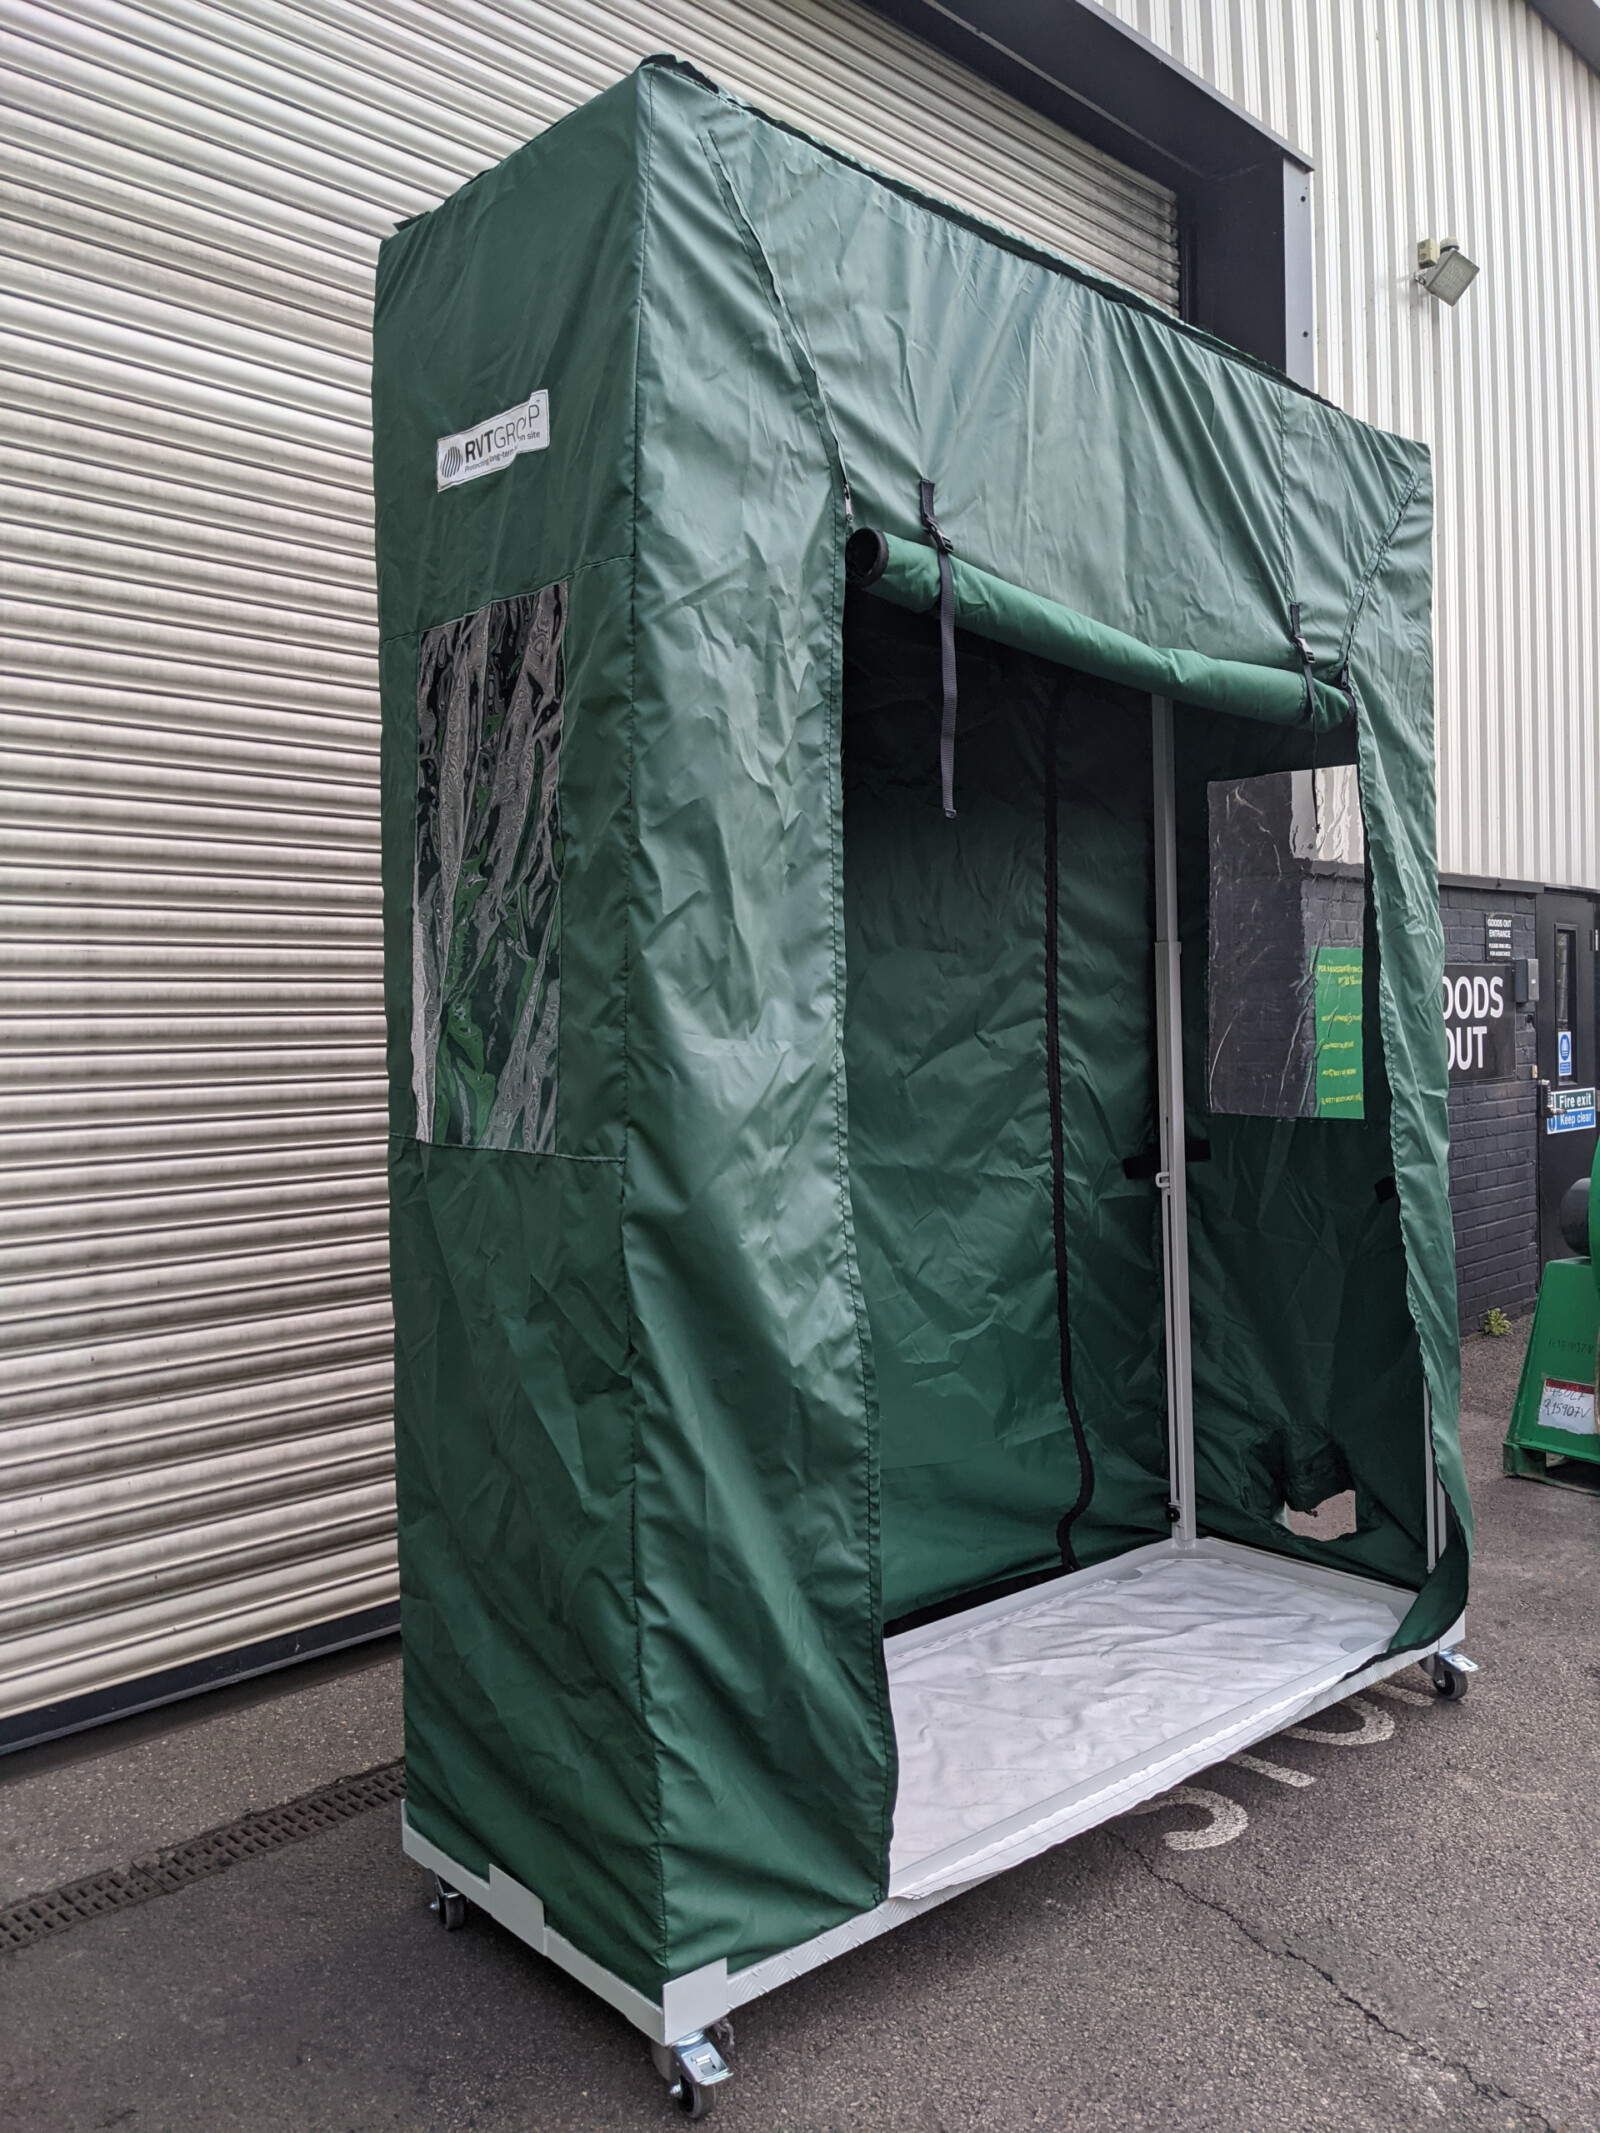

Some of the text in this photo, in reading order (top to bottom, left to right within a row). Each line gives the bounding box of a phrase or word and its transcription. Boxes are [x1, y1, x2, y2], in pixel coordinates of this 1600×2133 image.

[1488, 918, 1503, 927] GOODS
[1442, 975, 1504, 1020] OODS
[1560, 1092, 1591, 1108] Fire exit
[1560, 1112, 1592, 1127] Keep clear
